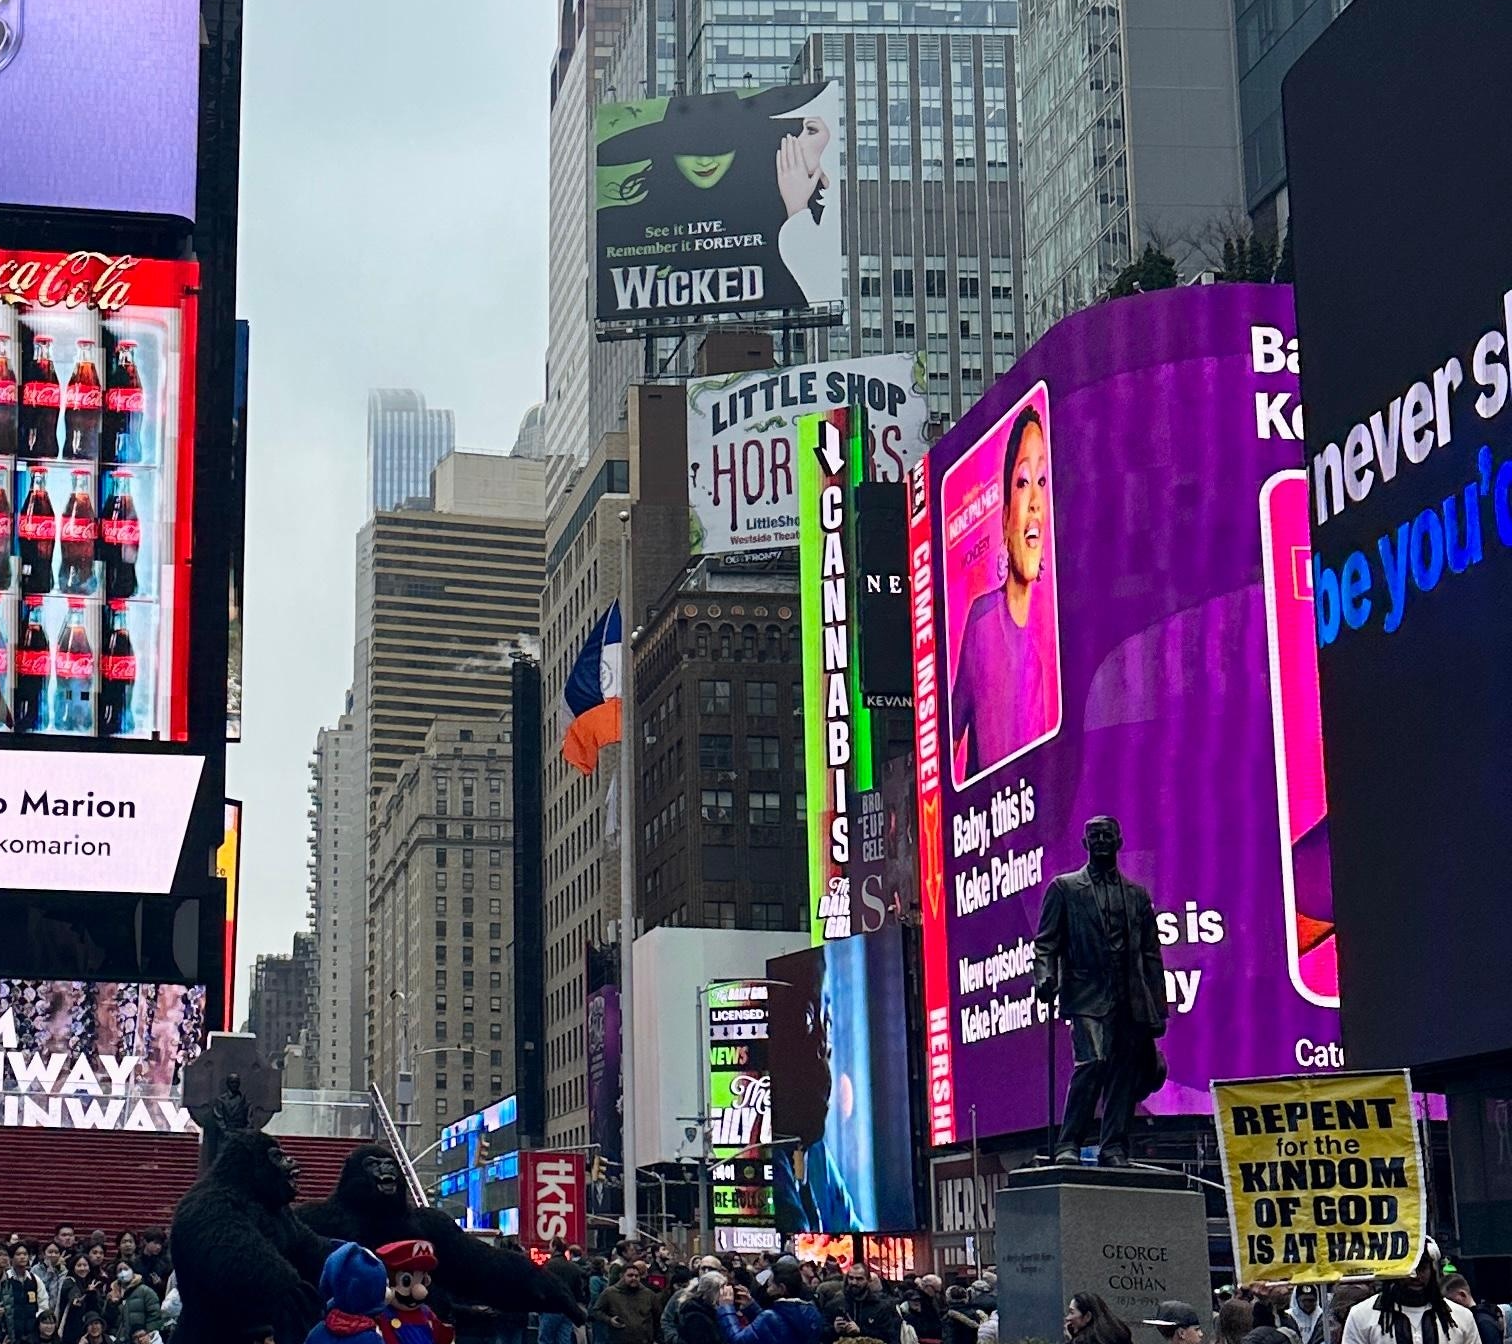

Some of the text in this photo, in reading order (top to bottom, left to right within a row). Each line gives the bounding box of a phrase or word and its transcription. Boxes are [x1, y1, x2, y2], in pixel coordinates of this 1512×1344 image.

[606, 240, 692, 259] Remember it
[645, 223, 685, 239] See it
[711, 371, 907, 437] LITTLE SHOP
[1314, 357, 1463, 527] never
[730, 533, 773, 546] Westside
[912, 541, 933, 649] COME
[1314, 549, 1372, 649] be
[821, 485, 850, 863] CANNABIS
[916, 656, 938, 794] INSIDE!
[20, 789, 137, 820] Marion
[952, 777, 1036, 859] Baby, this is
[954, 844, 1044, 917] Keke Palmer
[1185, 901, 1225, 945] is
[958, 937, 1037, 997] New episodes
[711, 1009, 765, 1022] LICENSED
[960, 1001, 991, 1045] Keke
[1231, 1097, 1397, 1136] REPENT
[1276, 1136, 1360, 1158] for the
[1239, 1157, 1409, 1193] KINDOM
[536, 1158, 576, 1241] tkts
[1254, 1194, 1399, 1228] OF GOD
[414, 1239, 435, 1258] M
[1102, 1243, 1168, 1262] GEORGE
[1247, 1229, 1411, 1265] IS AT HAND
[1108, 1275, 1168, 1292] COHAN
